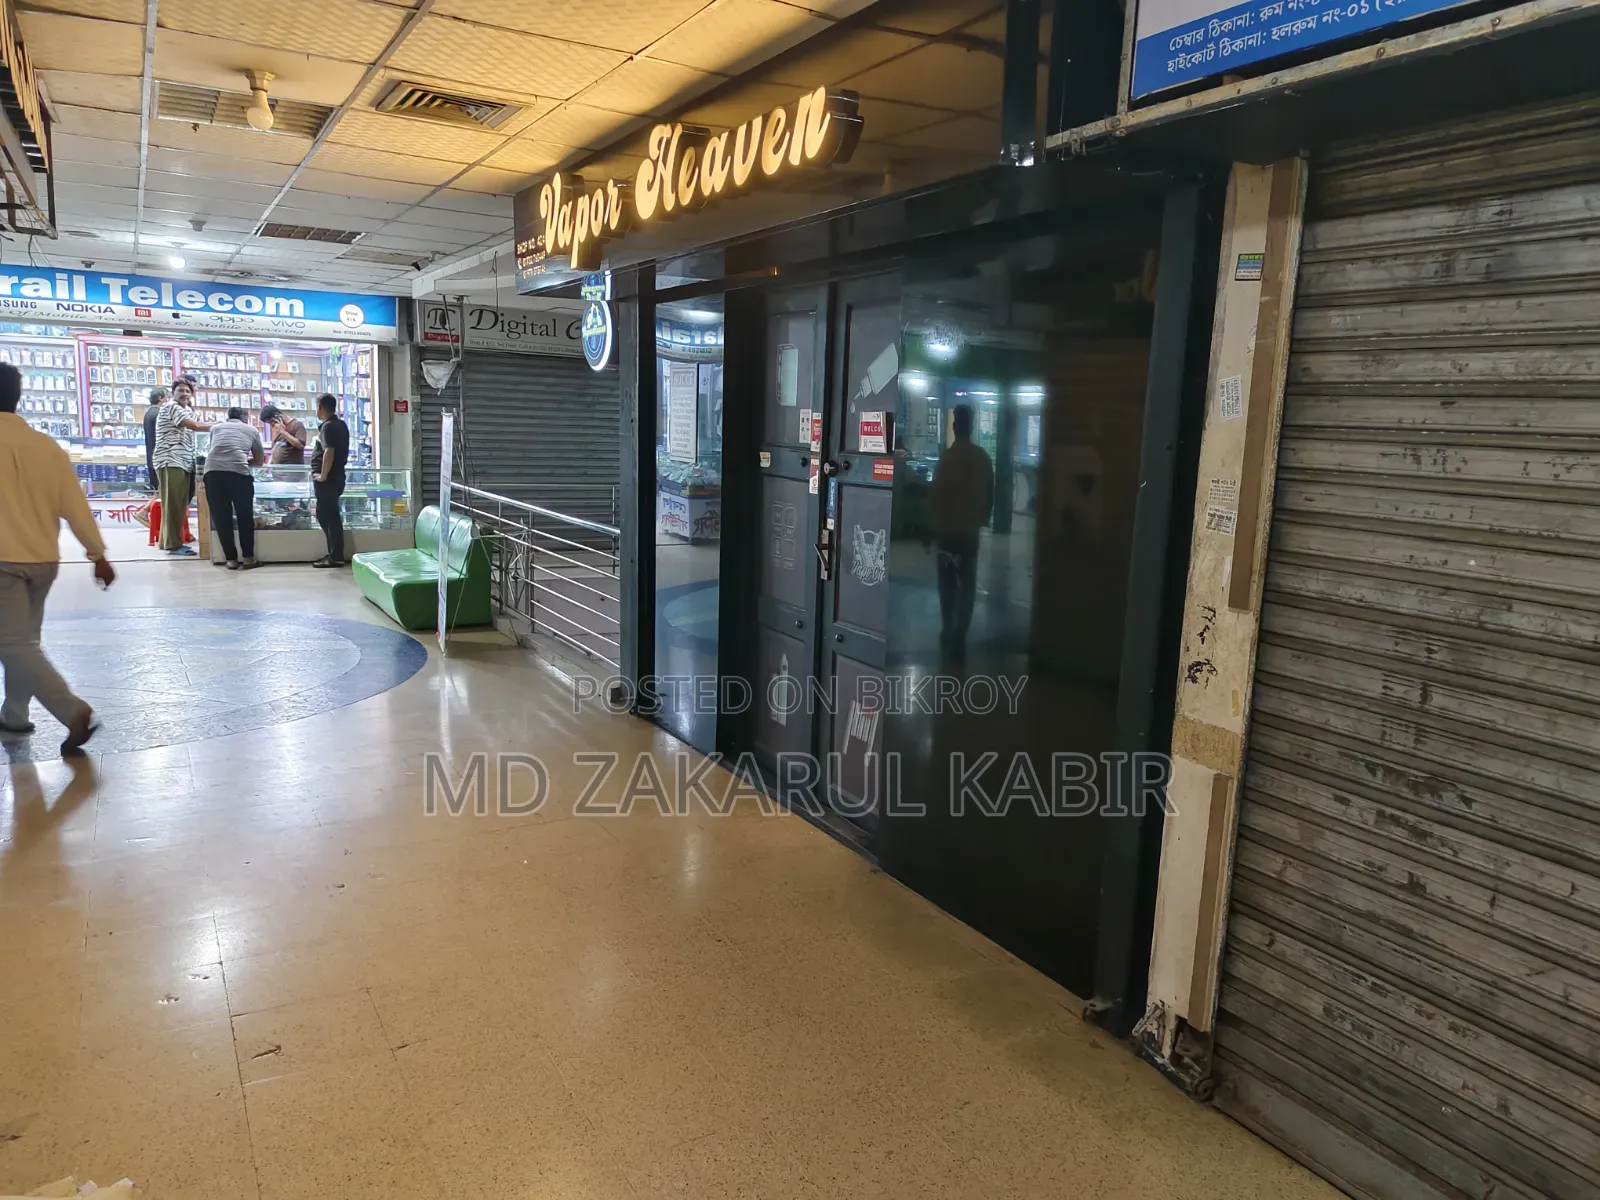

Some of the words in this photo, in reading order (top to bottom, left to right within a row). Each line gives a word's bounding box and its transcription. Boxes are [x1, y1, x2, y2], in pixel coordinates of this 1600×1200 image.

[1167, 41, 1216, 73] হাইকোর্ট
[1219, 31, 1267, 58] ঠিকানা:
[1271, 15, 1318, 41] হলরুম
[1169, 28, 1205, 51] চেম্বার
[1208, 11, 1255, 39] ঠিকানা:
[1259, 1, 1285, 22] রুম
[540, 172, 622, 269] Vapor
[635, 85, 831, 220] Heaven
[0, 299, 38, 309] SUNG
[56, 303, 116, 314] NOKIA
[271, 318, 306, 329] vivo
[101, 277, 304, 318] Telecom
[469, 308, 557, 340] Digital
